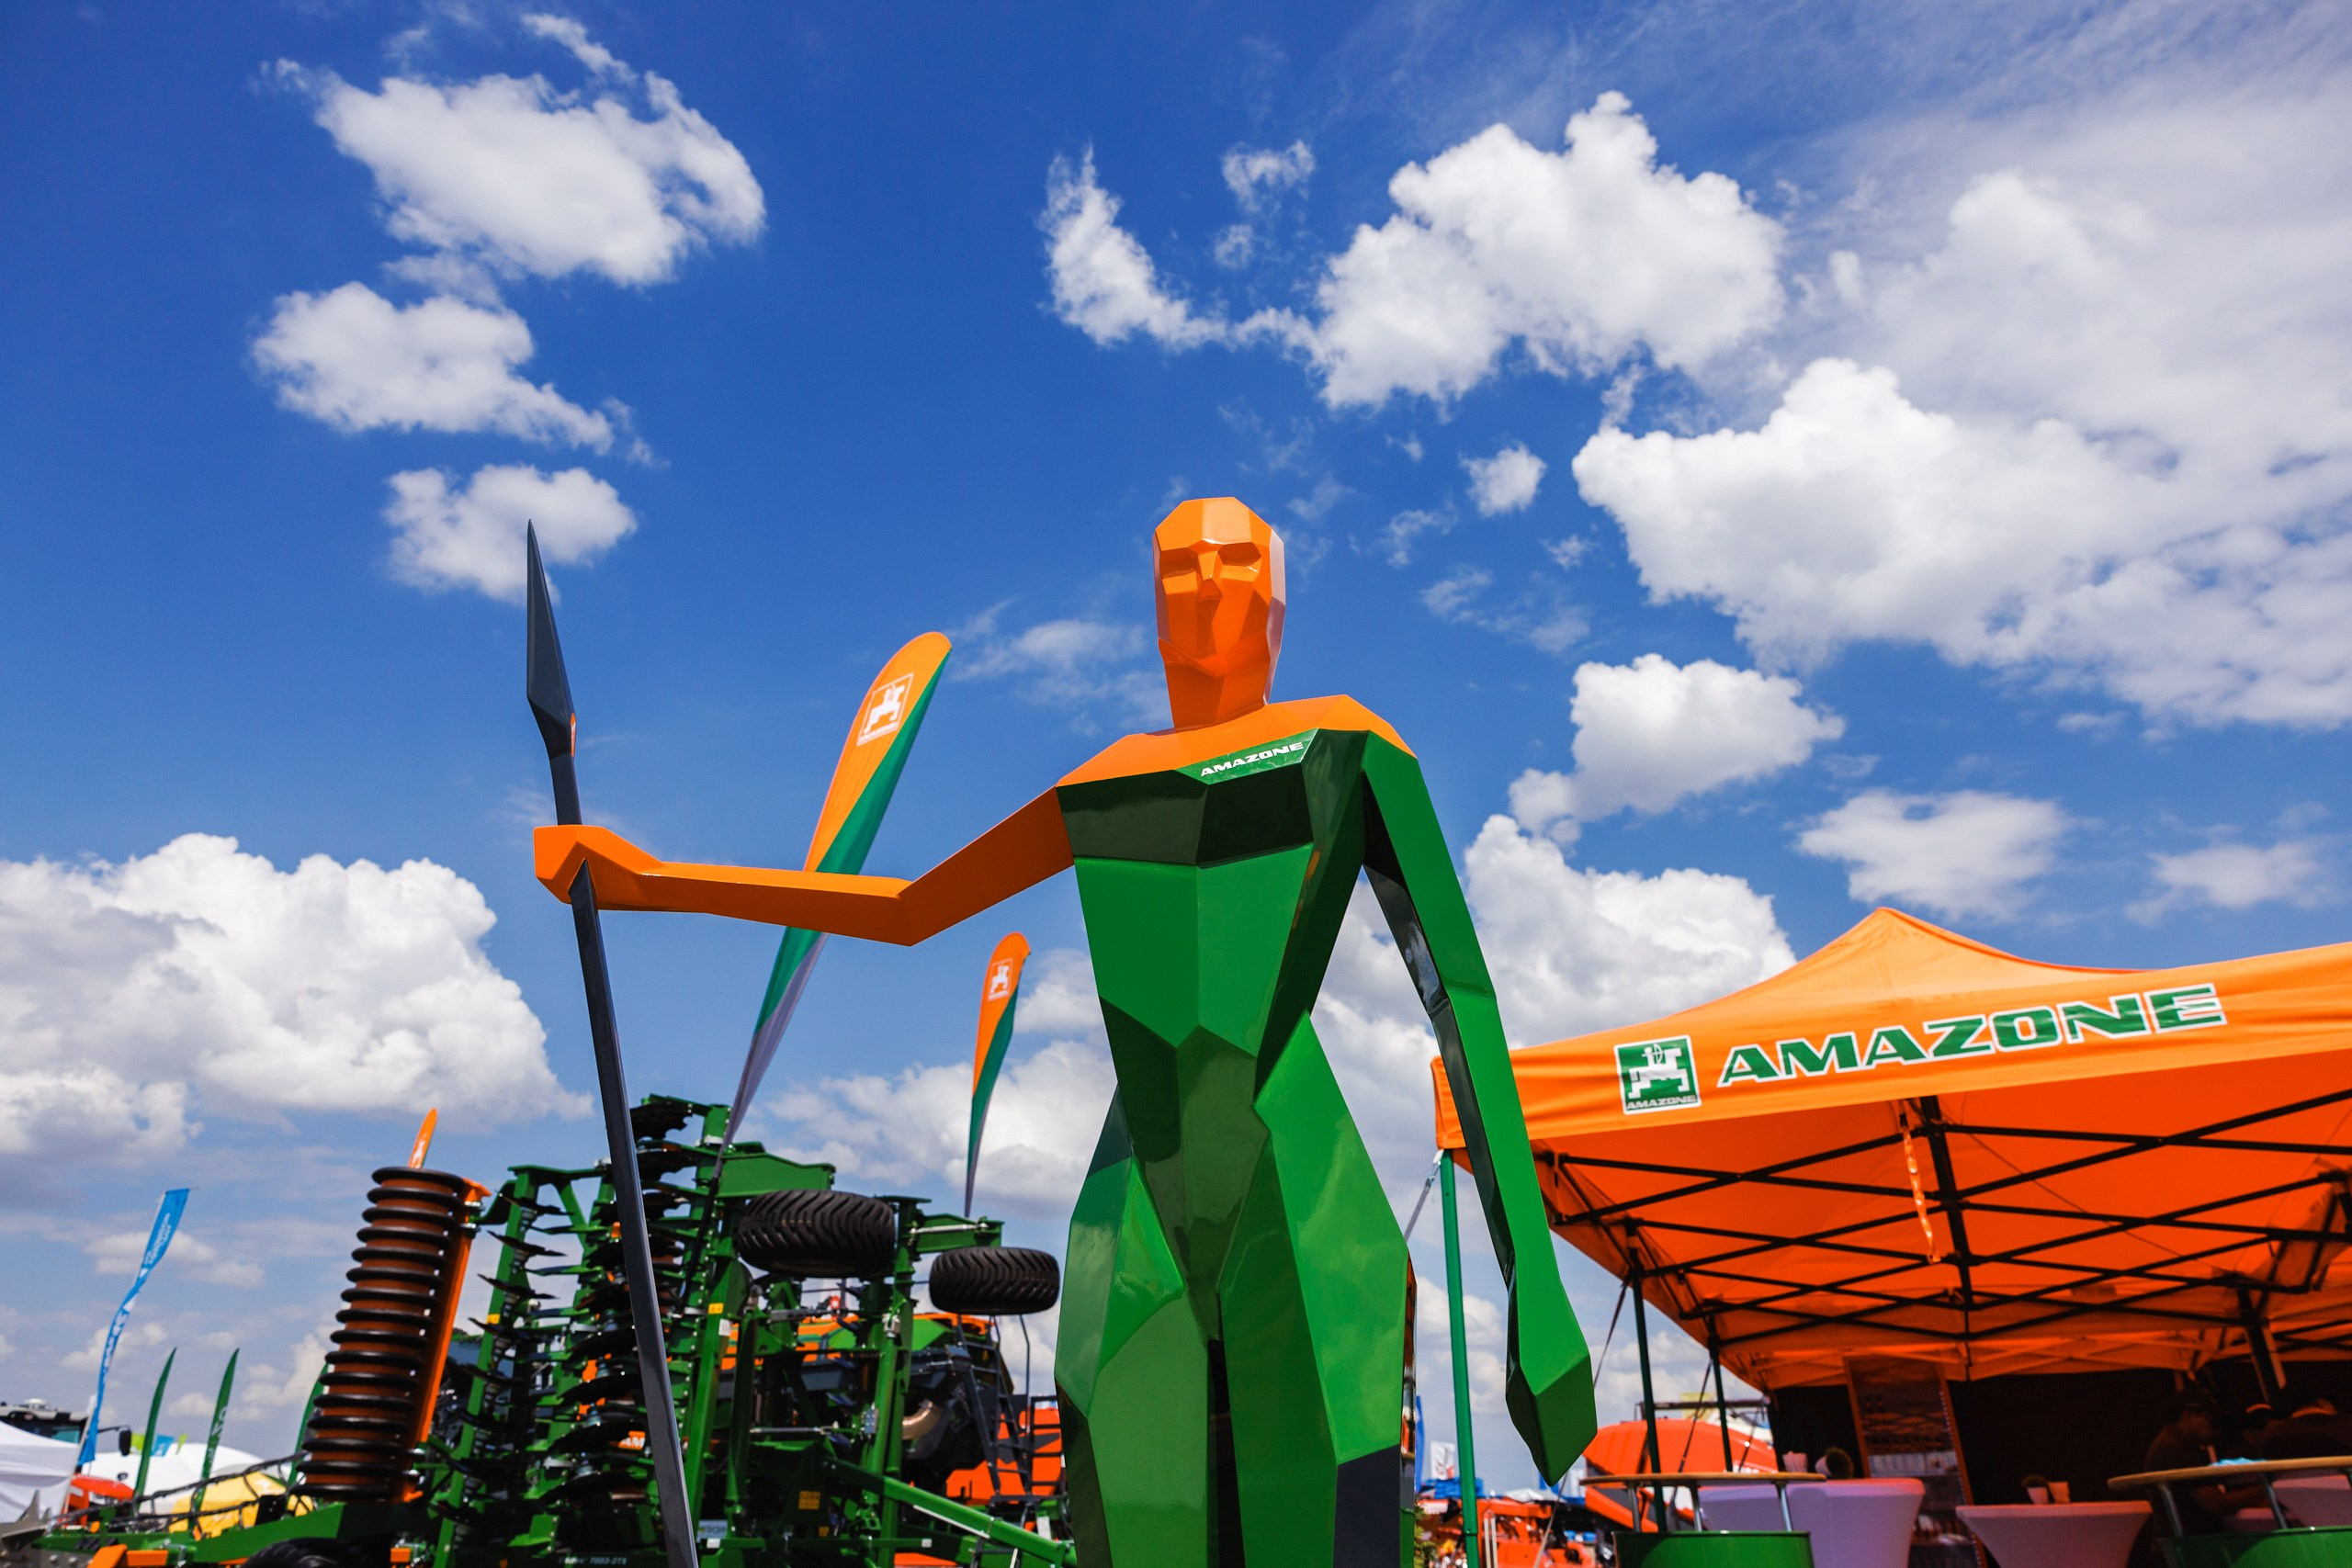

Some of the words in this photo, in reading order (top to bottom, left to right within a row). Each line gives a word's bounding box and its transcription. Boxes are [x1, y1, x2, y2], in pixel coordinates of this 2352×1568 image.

[1201, 742, 1304, 776] AMAZONE
[1717, 983, 2227, 1088] AMAZONE
[1627, 1095, 1696, 1109] AMAZONE
